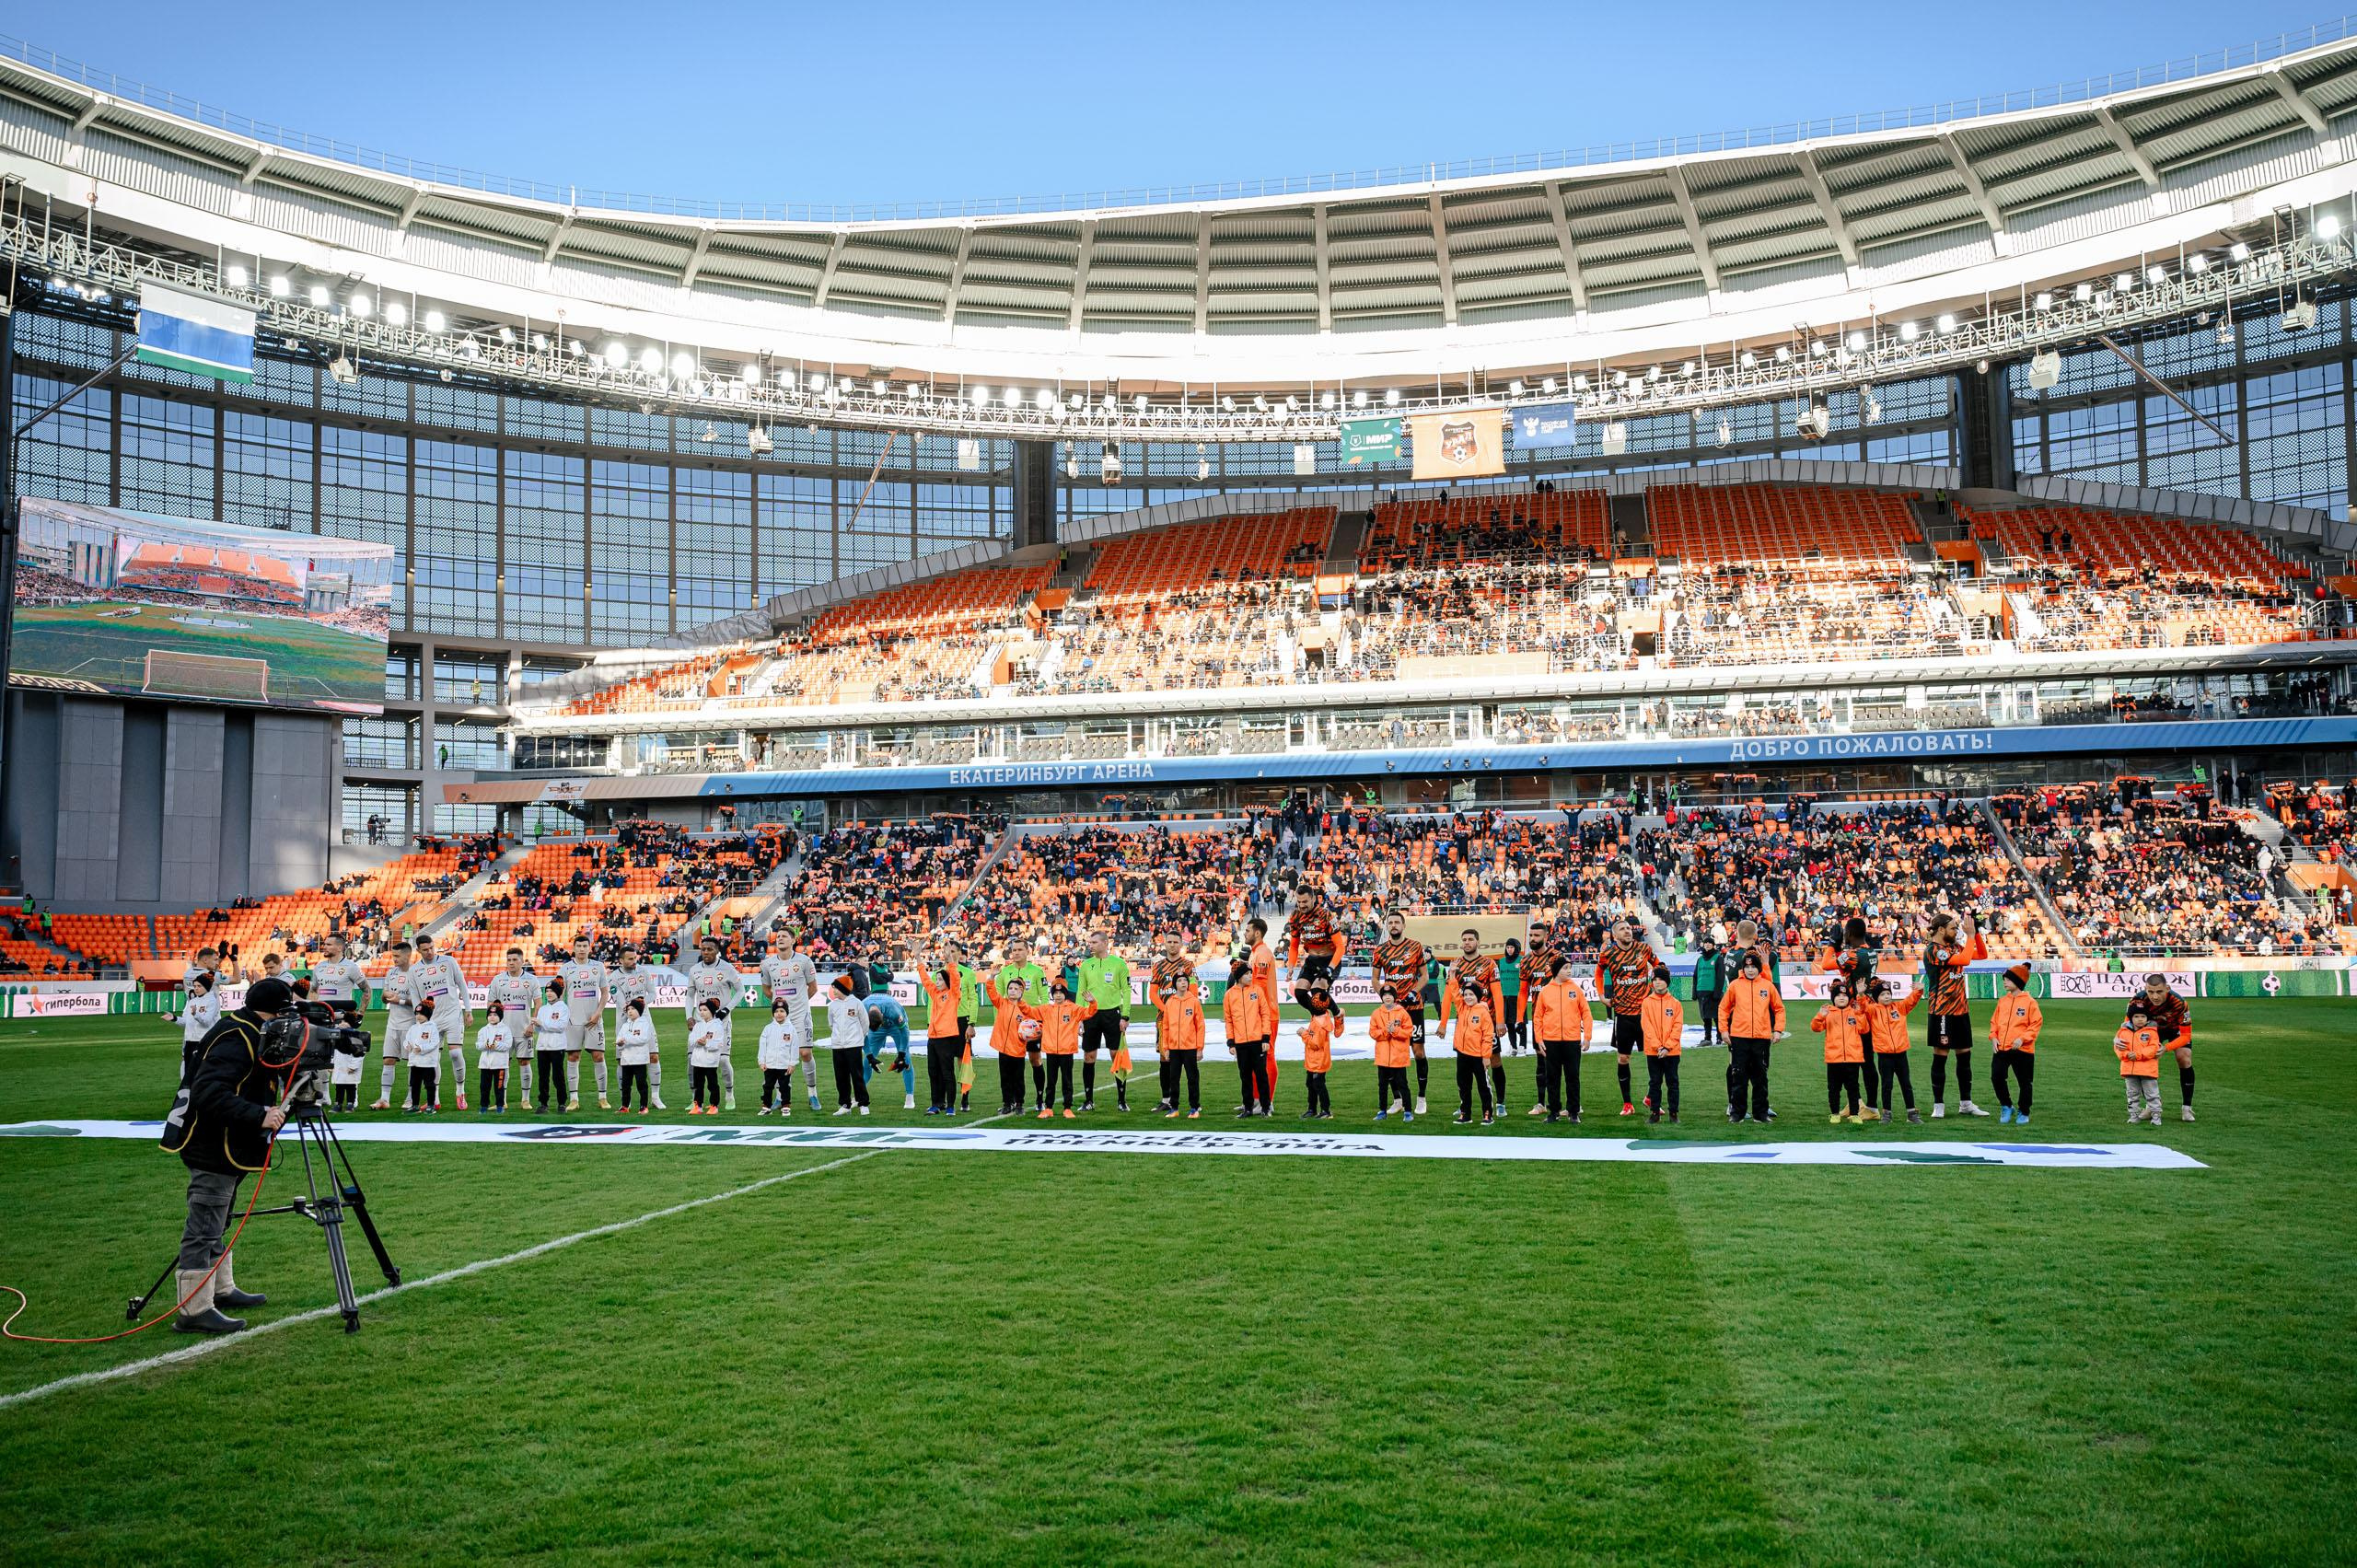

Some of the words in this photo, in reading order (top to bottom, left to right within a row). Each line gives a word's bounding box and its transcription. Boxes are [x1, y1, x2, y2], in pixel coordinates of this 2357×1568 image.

[1365, 434, 1393, 445] МИР
[1730, 739, 1810, 761] ДОБРО
[1819, 730, 1993, 754] ПОЖАЛОВАТЬ!
[949, 765, 1087, 784] ЕКАТЕРИНБУРГ
[1092, 762, 1155, 779] АРЕНА
[432, 979, 447, 987] ИКС
[45, 995, 101, 1012] гипербола
[1412, 1024, 1423, 1038] 24
[665, 1130, 988, 1143] МИР
